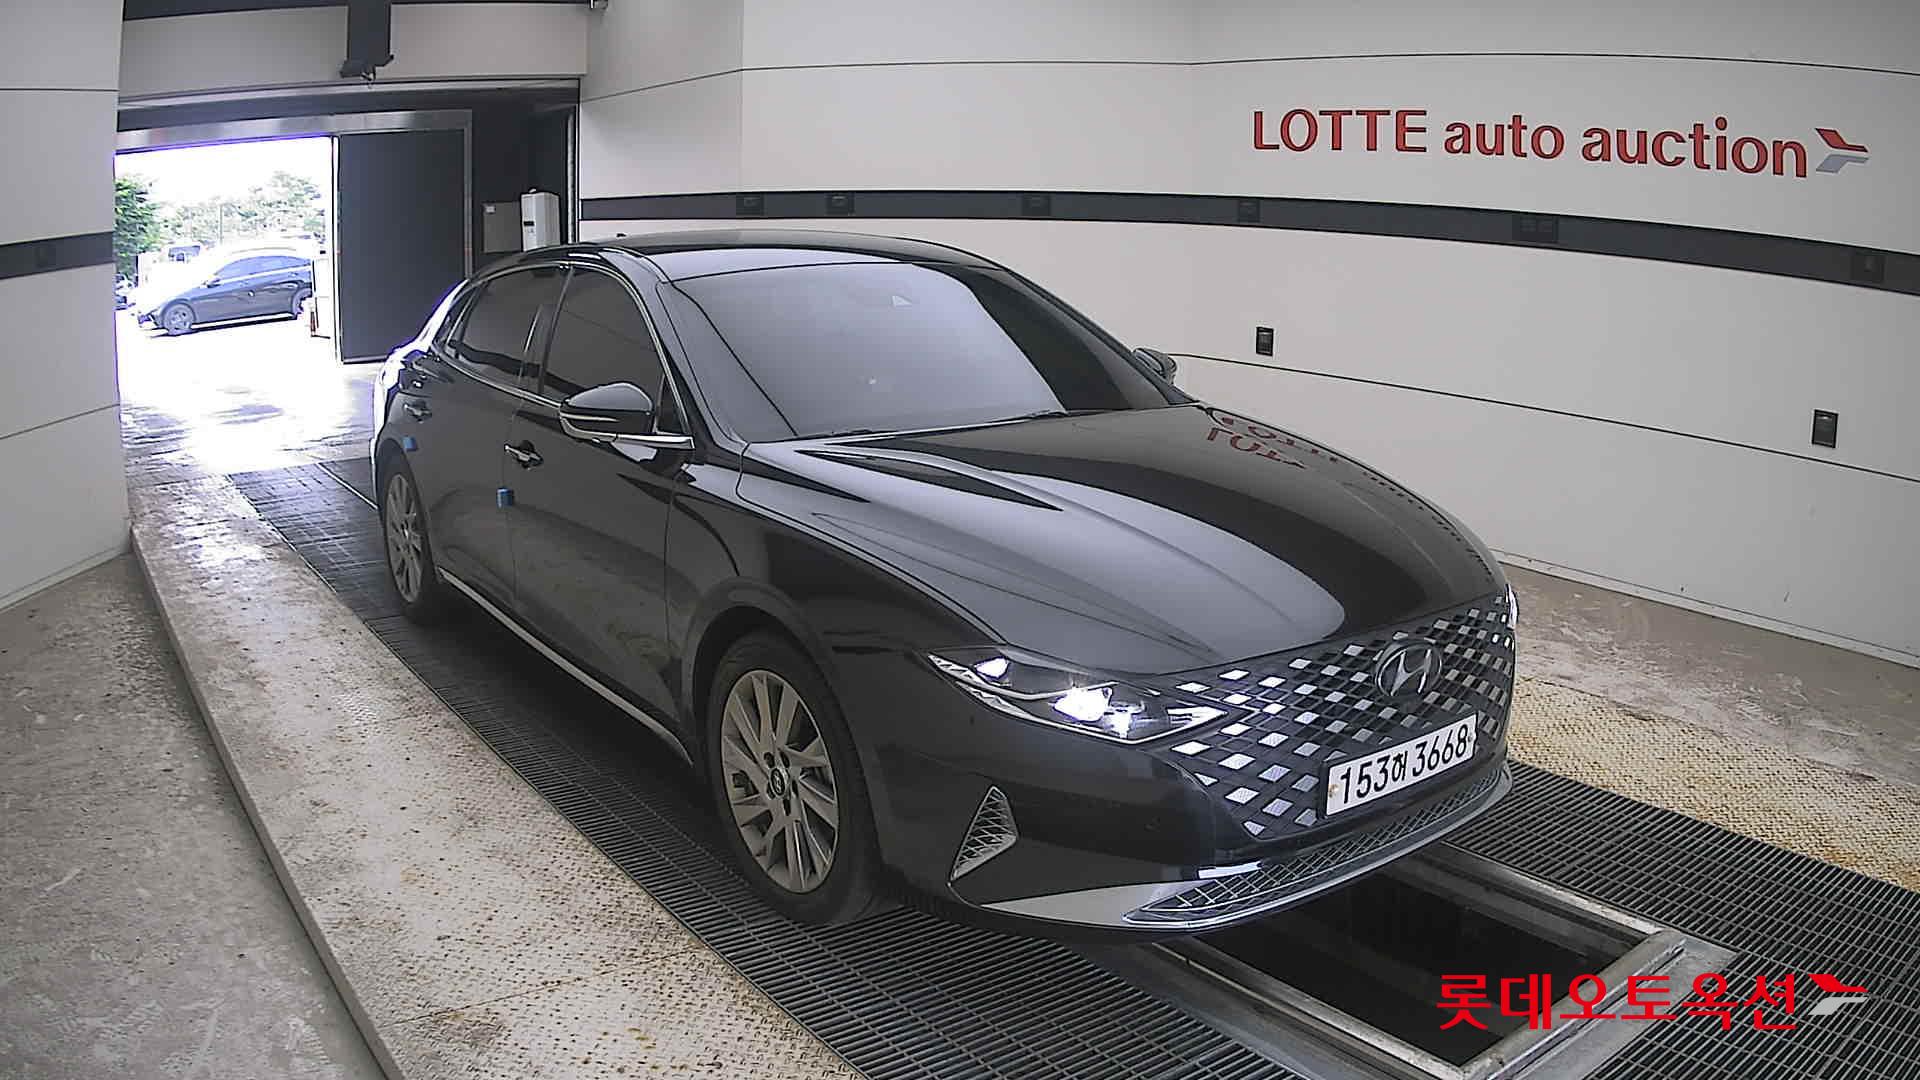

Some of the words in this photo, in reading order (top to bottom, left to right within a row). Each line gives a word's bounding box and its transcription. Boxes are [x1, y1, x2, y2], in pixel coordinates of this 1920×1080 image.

[1253, 109, 1427, 153] LOTTE
[1444, 114, 1565, 159] auto
[1581, 117, 1807, 178] auction
